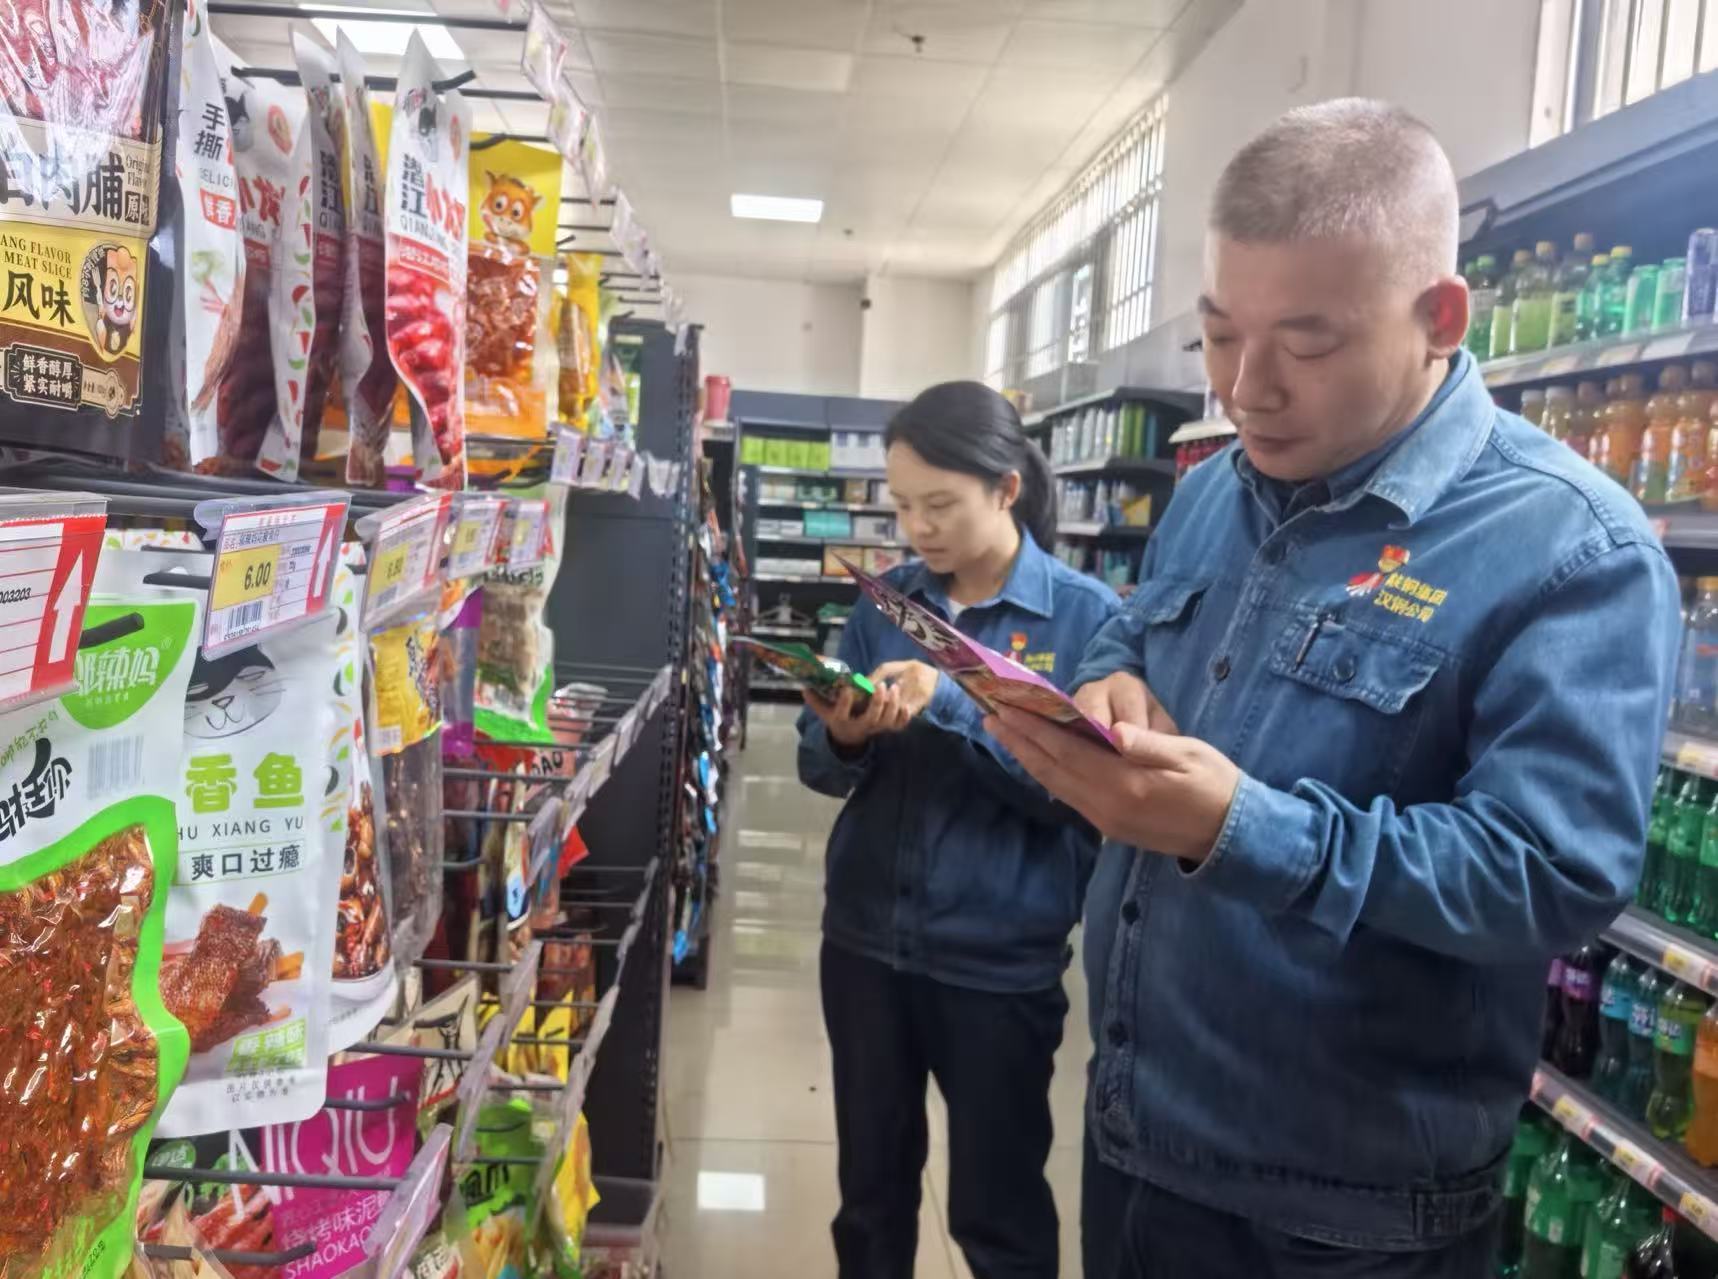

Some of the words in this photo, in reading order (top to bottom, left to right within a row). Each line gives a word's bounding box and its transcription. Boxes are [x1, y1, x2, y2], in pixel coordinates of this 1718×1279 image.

[0, 233, 27, 251] ANG
[30, 241, 72, 264] FLAVOR
[4, 250, 40, 270] MEAT
[41, 260, 73, 280] SLICE
[2, 269, 76, 328] 风味
[22, 354, 73, 380] 鲜香醇厚
[244, 562, 272, 590] 6.00
[185, 752, 305, 815] 香鱼
[212, 819, 271, 837] XIANG
[285, 815, 304, 831] YU
[191, 845, 301, 881] 爽口过瘾
